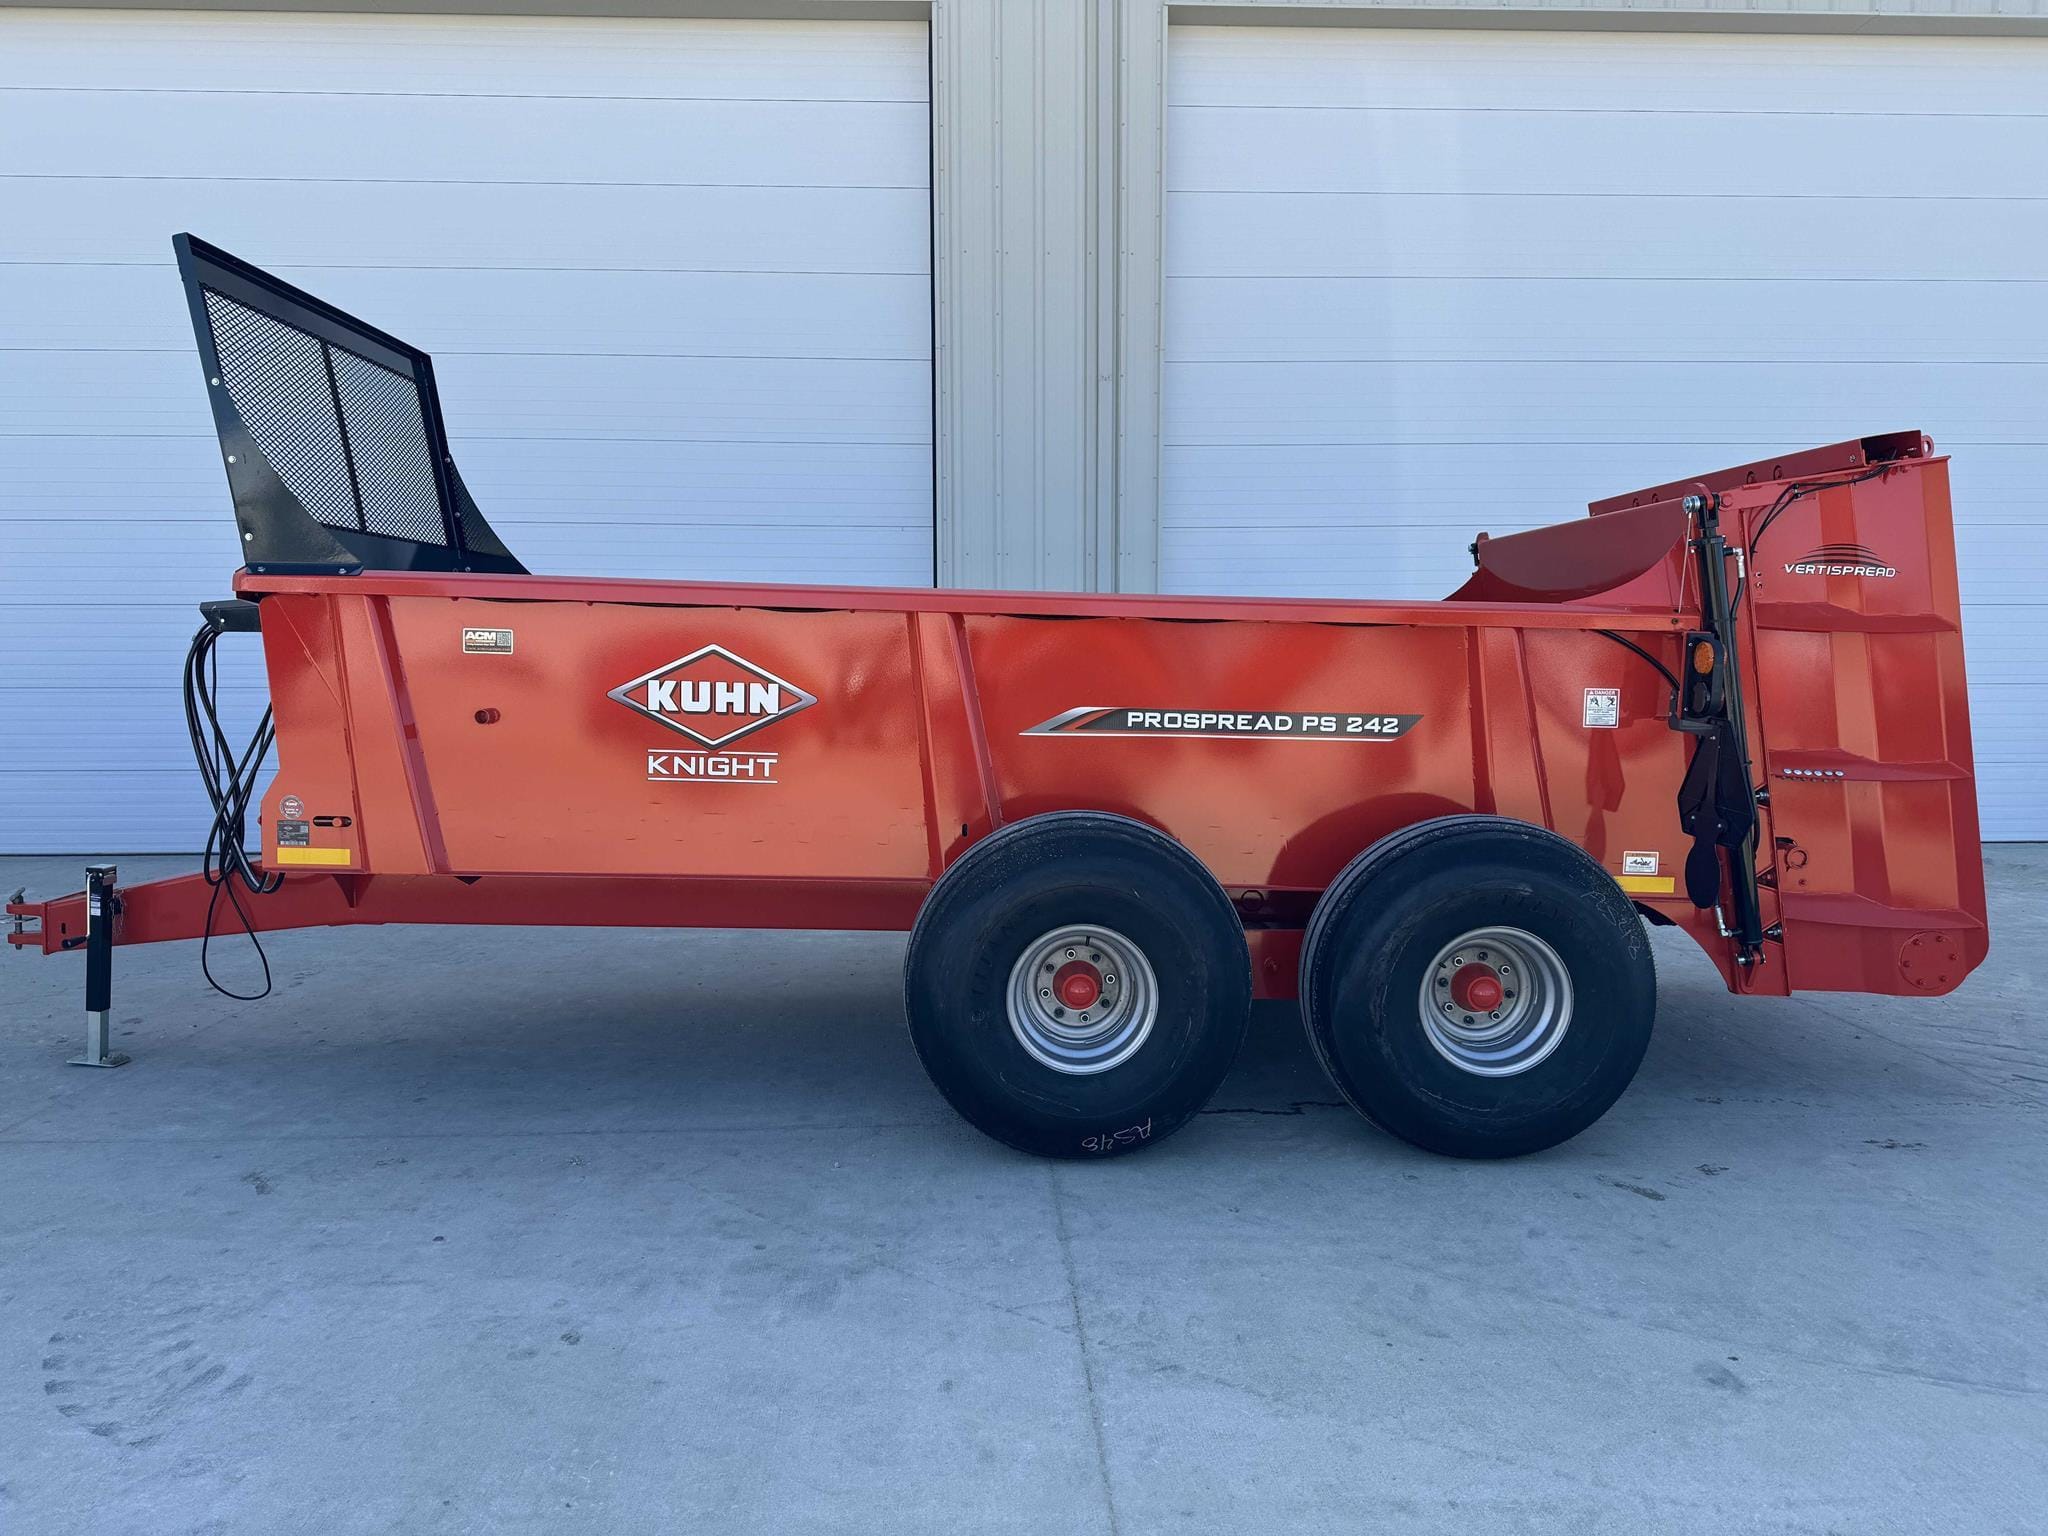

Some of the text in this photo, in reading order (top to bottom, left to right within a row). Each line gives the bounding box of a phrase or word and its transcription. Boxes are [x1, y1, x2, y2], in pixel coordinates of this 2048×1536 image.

[1784, 563, 1897, 578] VERTISPREAD
[465, 631, 497, 641] ACM
[647, 679, 780, 715] KUHN
[1127, 711, 1399, 733] PROSPREAD PS 242
[647, 755, 778, 777] KNIGHT
